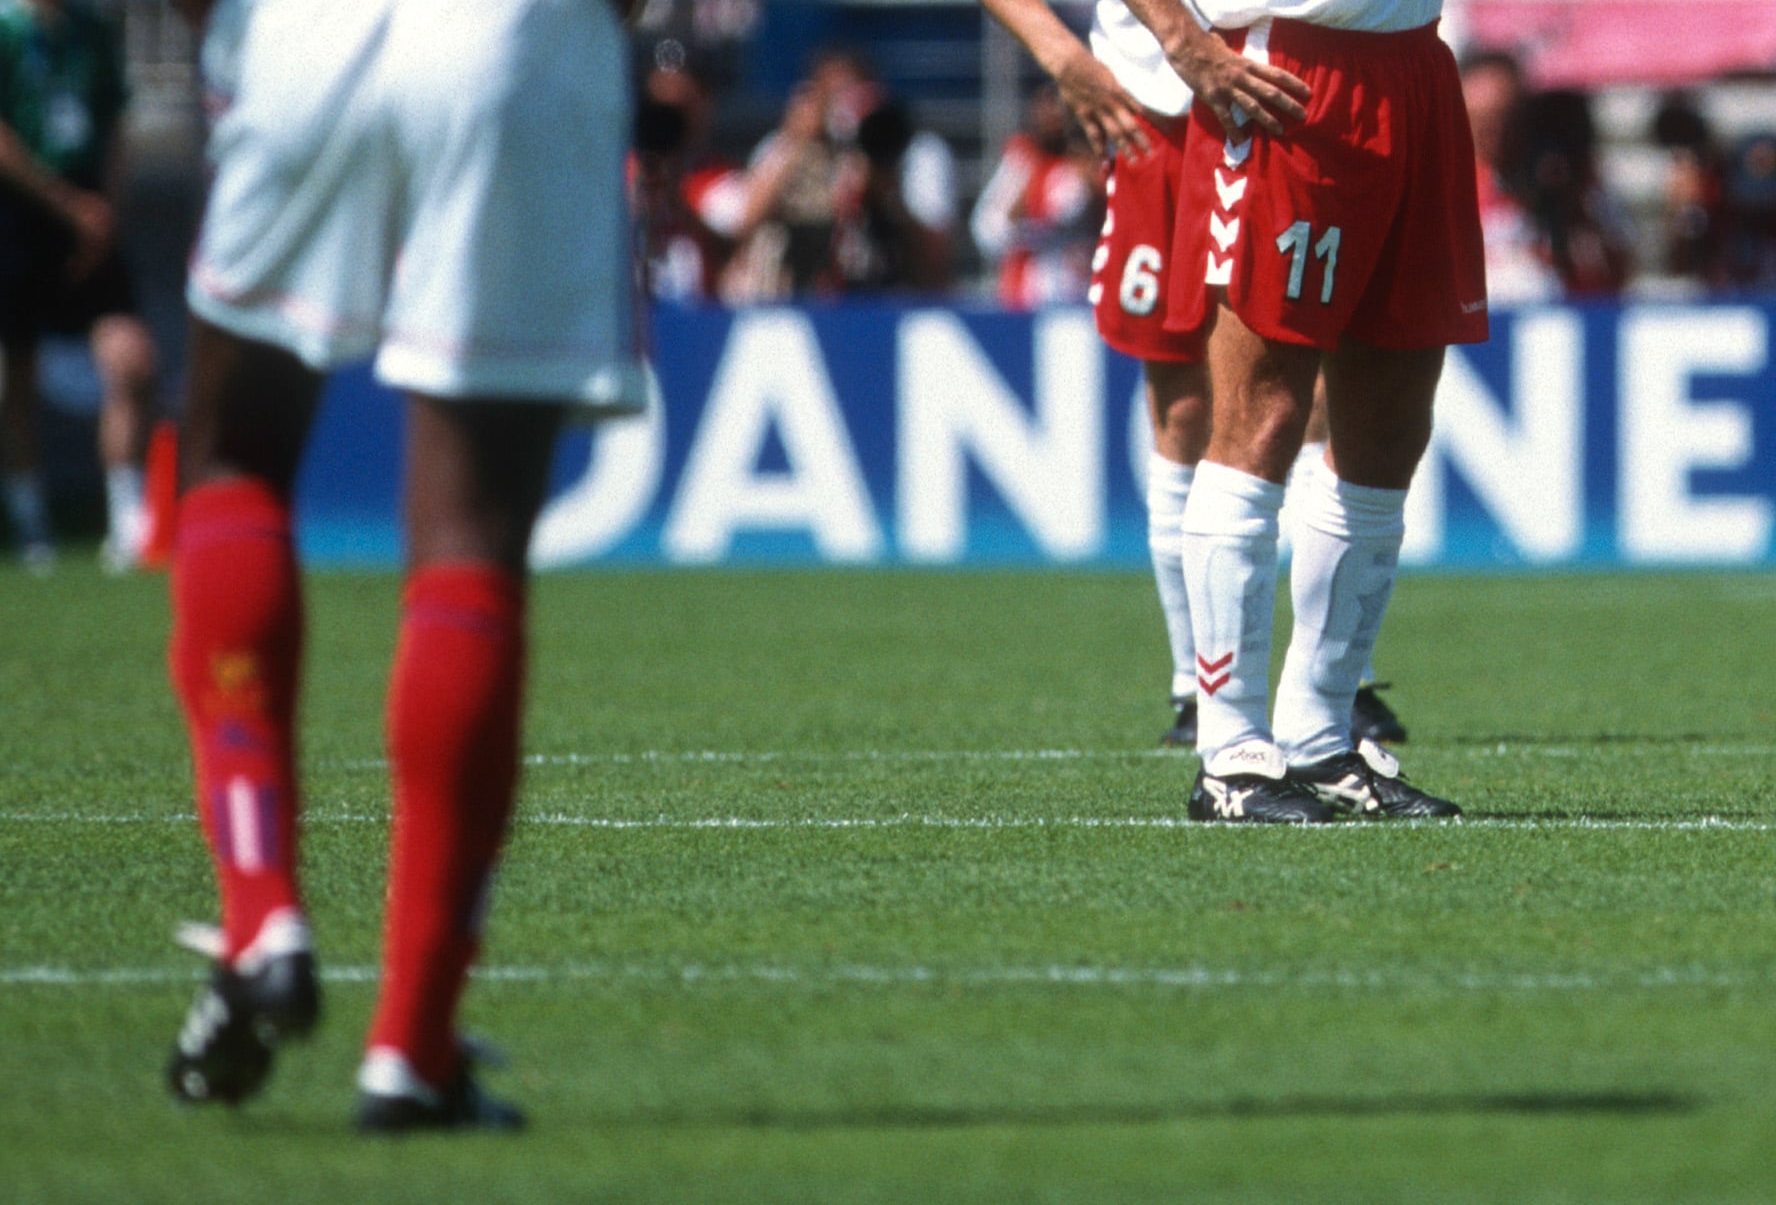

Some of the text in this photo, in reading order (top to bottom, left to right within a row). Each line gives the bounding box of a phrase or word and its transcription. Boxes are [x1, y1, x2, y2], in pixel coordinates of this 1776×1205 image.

[1119, 244, 1162, 315] 6
[1276, 221, 1341, 303] 11
[526, 305, 1772, 569] ANNE
